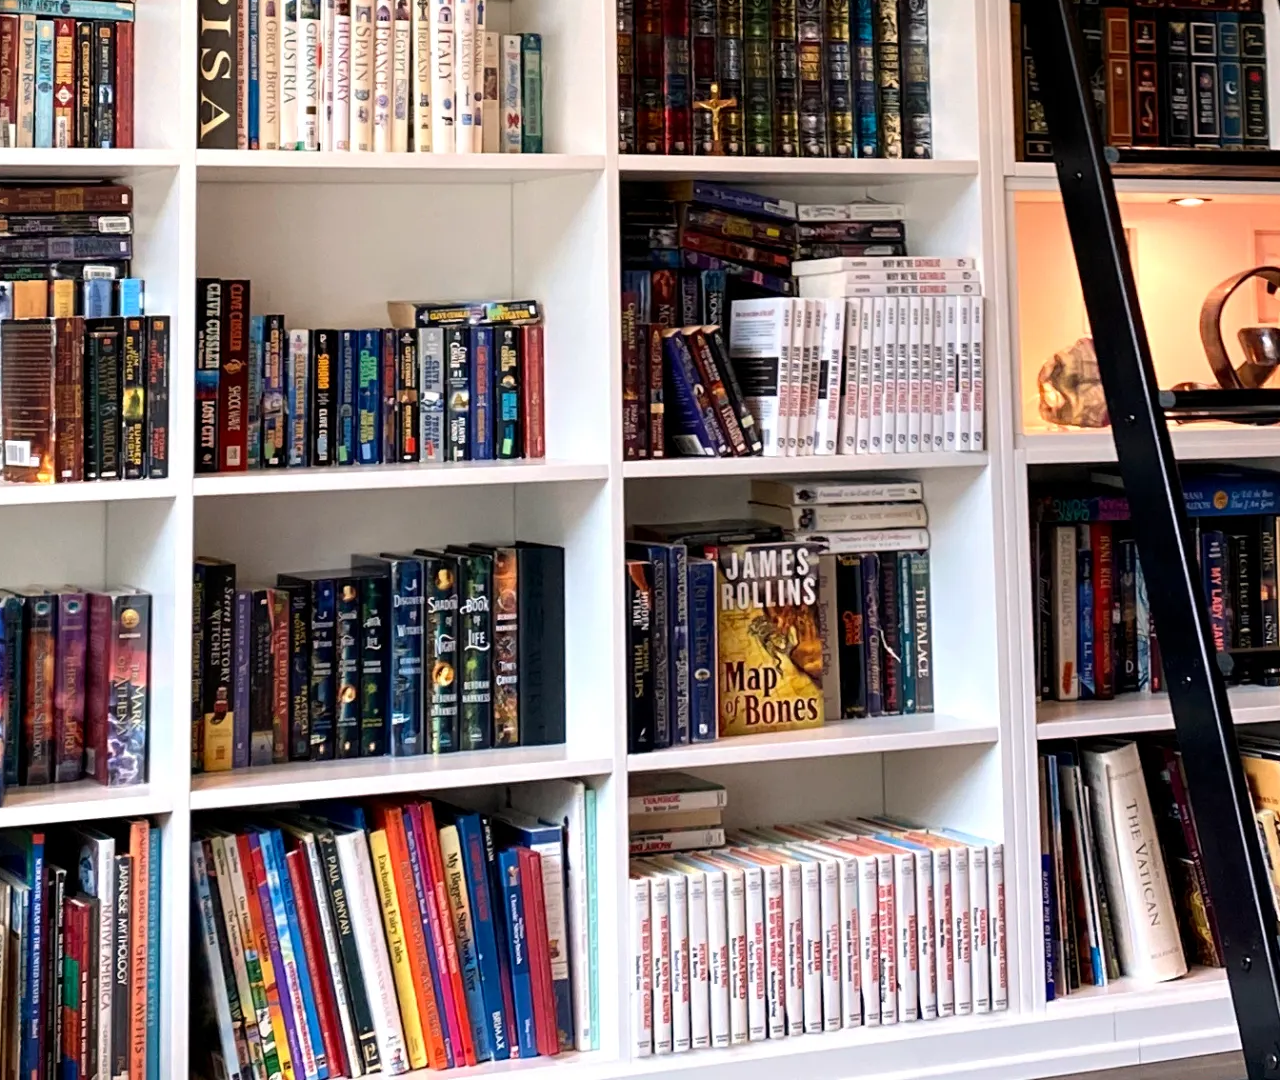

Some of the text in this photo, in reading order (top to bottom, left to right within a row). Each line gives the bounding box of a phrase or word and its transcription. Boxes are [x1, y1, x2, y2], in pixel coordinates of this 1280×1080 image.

[265, 20, 278, 124] GREAT BRITAIN
[283, 27, 297, 104] AUSTRIA
[305, 23, 318, 100] GERMANY
[336, 22, 349, 104] HUNGARY
[354, 23, 372, 82] SPAIN
[374, 26, 392, 90] FRANCE
[394, 28, 408, 76] EGYPT
[417, 26, 429, 83] IRELAND
[437, 28, 453, 82] ITALY
[205, 283, 220, 369] CLIVE CUSSLER
[201, 401, 215, 448] LOST CITY
[721, 576, 817, 611] ROLLINS
[725, 547, 810, 581] JAMES
[1209, 567, 1222, 620] MY LADY
[460, 596, 489, 614] BOOK
[915, 589, 930, 679] THE PALACE
[464, 629, 490, 651] LIFE
[114, 675, 129, 736] ATHENA
[130, 685, 145, 728] MARK
[724, 660, 778, 698] Map
[725, 694, 819, 726] of Bones
[1125, 798, 1160, 927] THE VATICAN
[117, 863, 130, 986] JAPANESE MYTHOLOGY
[326, 856, 351, 935] PAUL BUNYAN
[378, 854, 402, 964] Enchanting Fairy Tales
[448, 851, 472, 963] My Biggest Storybook
[100, 904, 114, 1011] NATIVE AMERICA
[491, 1011, 505, 1051] BRIMAX
